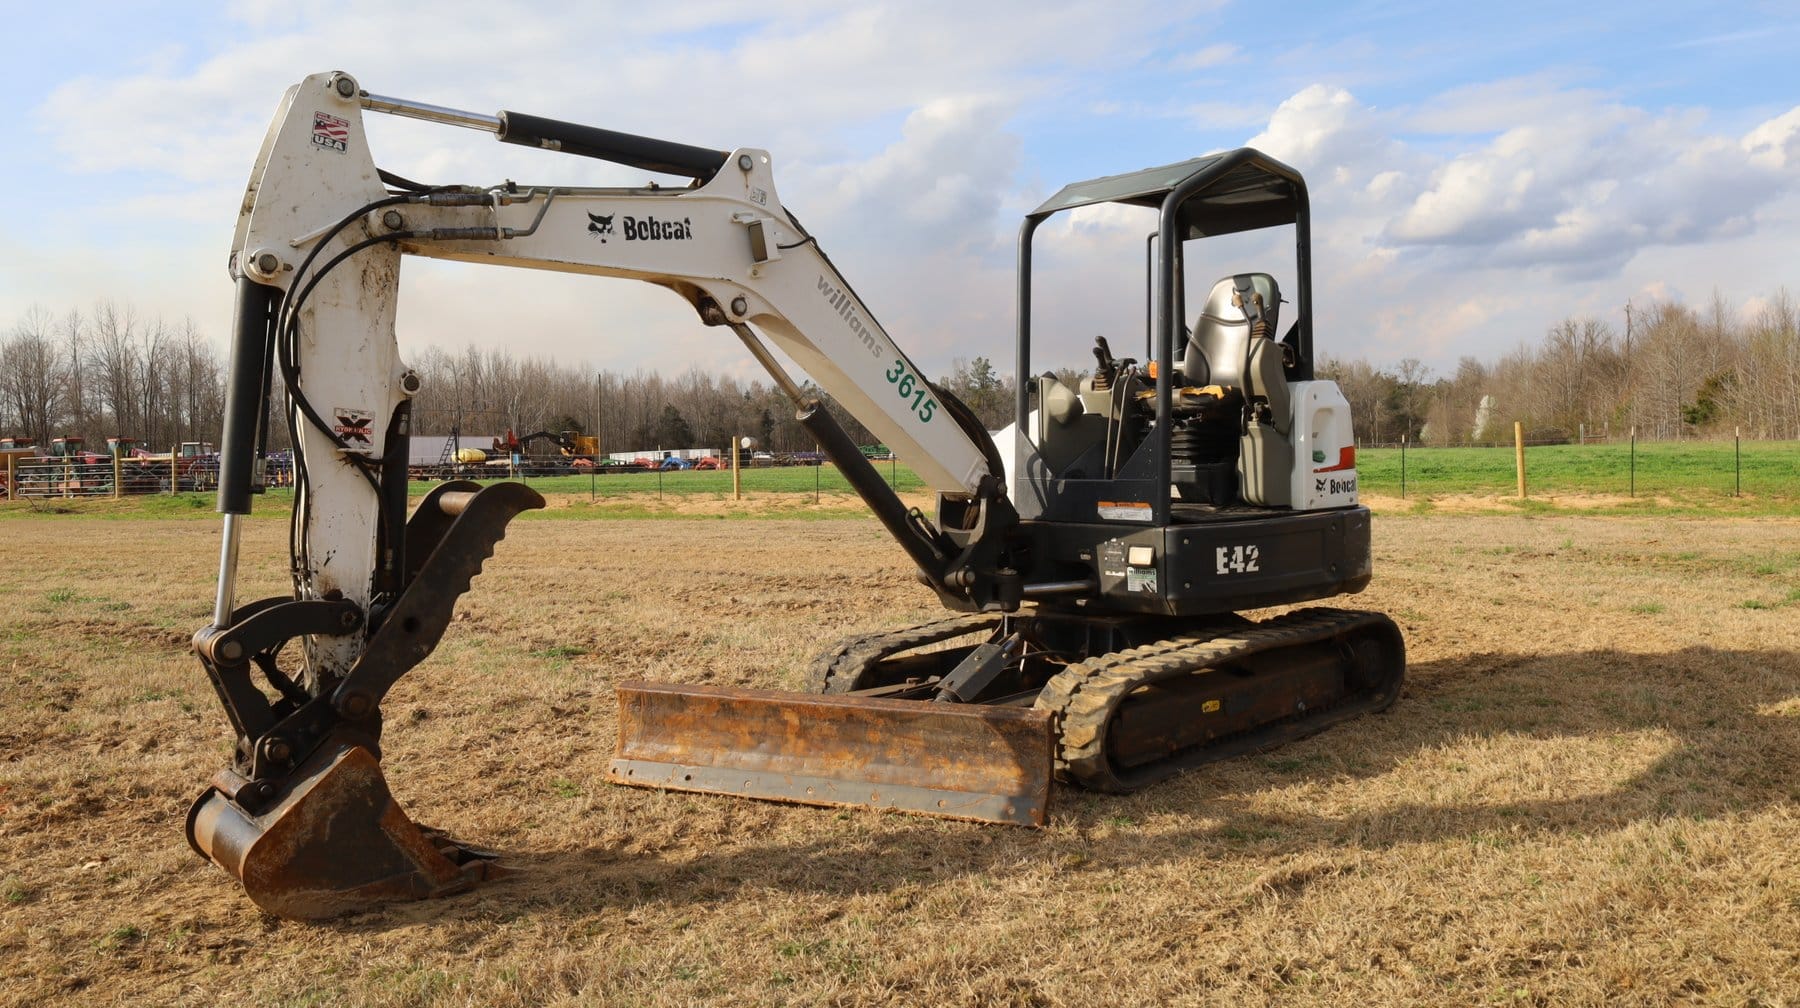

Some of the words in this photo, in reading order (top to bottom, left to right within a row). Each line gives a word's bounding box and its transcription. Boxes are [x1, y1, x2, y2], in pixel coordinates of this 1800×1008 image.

[314, 134, 344, 151] USA
[623, 215, 693, 241] Bobcat
[817, 275, 883, 358] williams
[886, 359, 938, 423] 3615
[1216, 545, 1260, 574] E42
